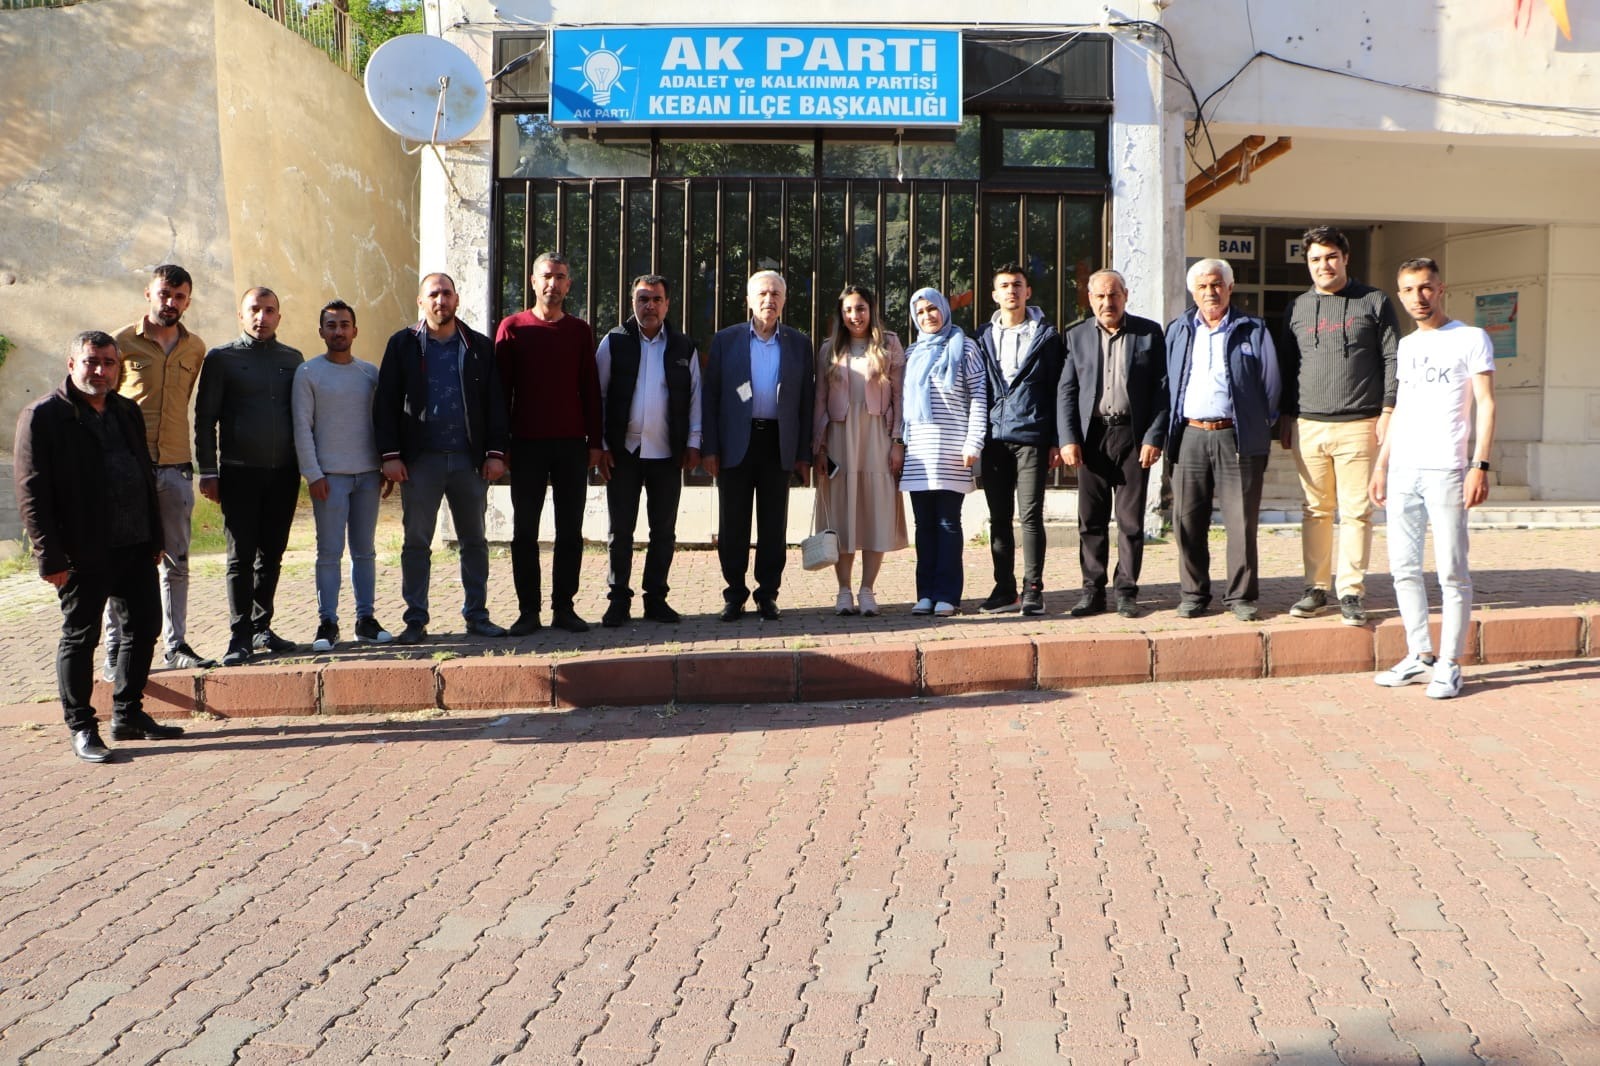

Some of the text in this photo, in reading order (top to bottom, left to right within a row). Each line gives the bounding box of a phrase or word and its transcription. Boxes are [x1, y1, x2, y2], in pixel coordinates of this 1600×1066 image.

[660, 36, 745, 71] AK
[659, 73, 938, 90] ADALET ve KALKINMA PARTİSİ
[573, 108, 592, 119] AK
[649, 89, 947, 120] KEBAN İLÇE BAŞKANLIĞI
